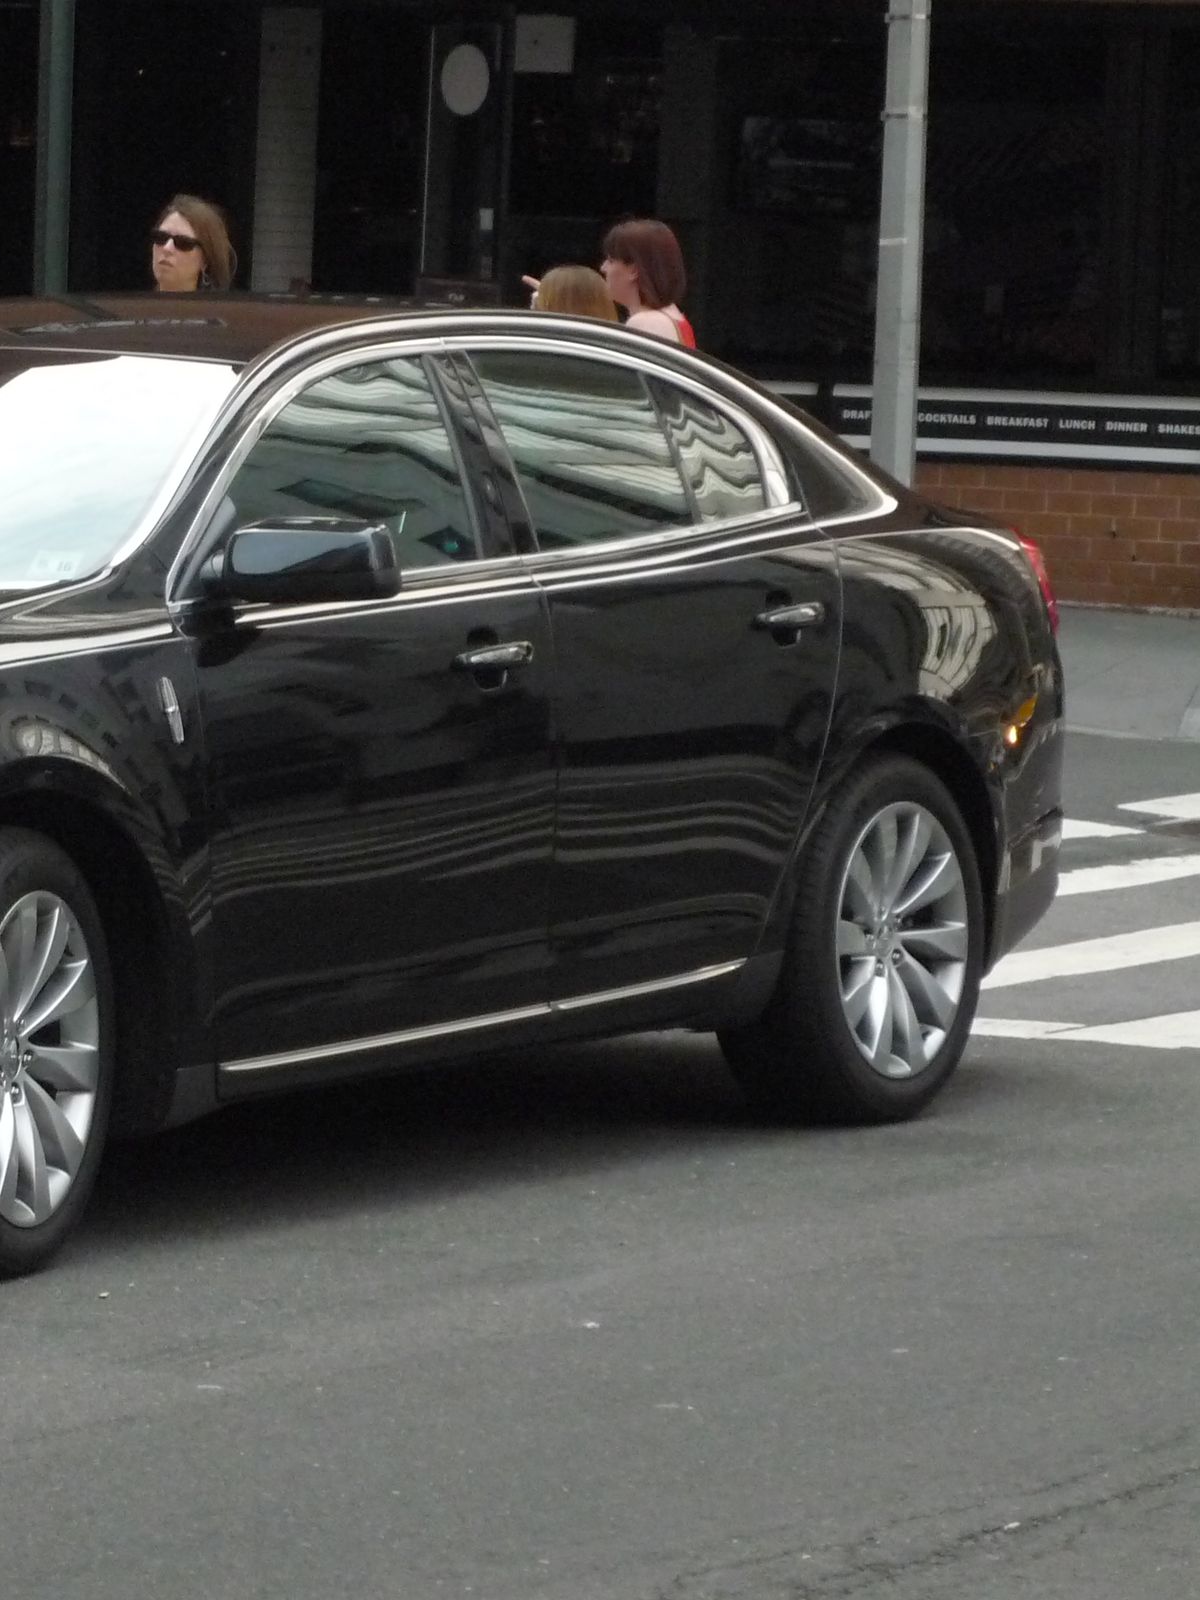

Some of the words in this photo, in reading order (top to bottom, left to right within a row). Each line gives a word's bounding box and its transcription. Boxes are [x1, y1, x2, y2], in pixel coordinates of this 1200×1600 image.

[843, 409, 872, 420] DRAF
[918, 412, 977, 425] COCKTAILS
[987, 415, 1049, 429] BREAKFAST
[1059, 419, 1097, 430] LUNCH
[1105, 421, 1148, 433] DINNER
[1158, 423, 1200, 435] SHAKES
